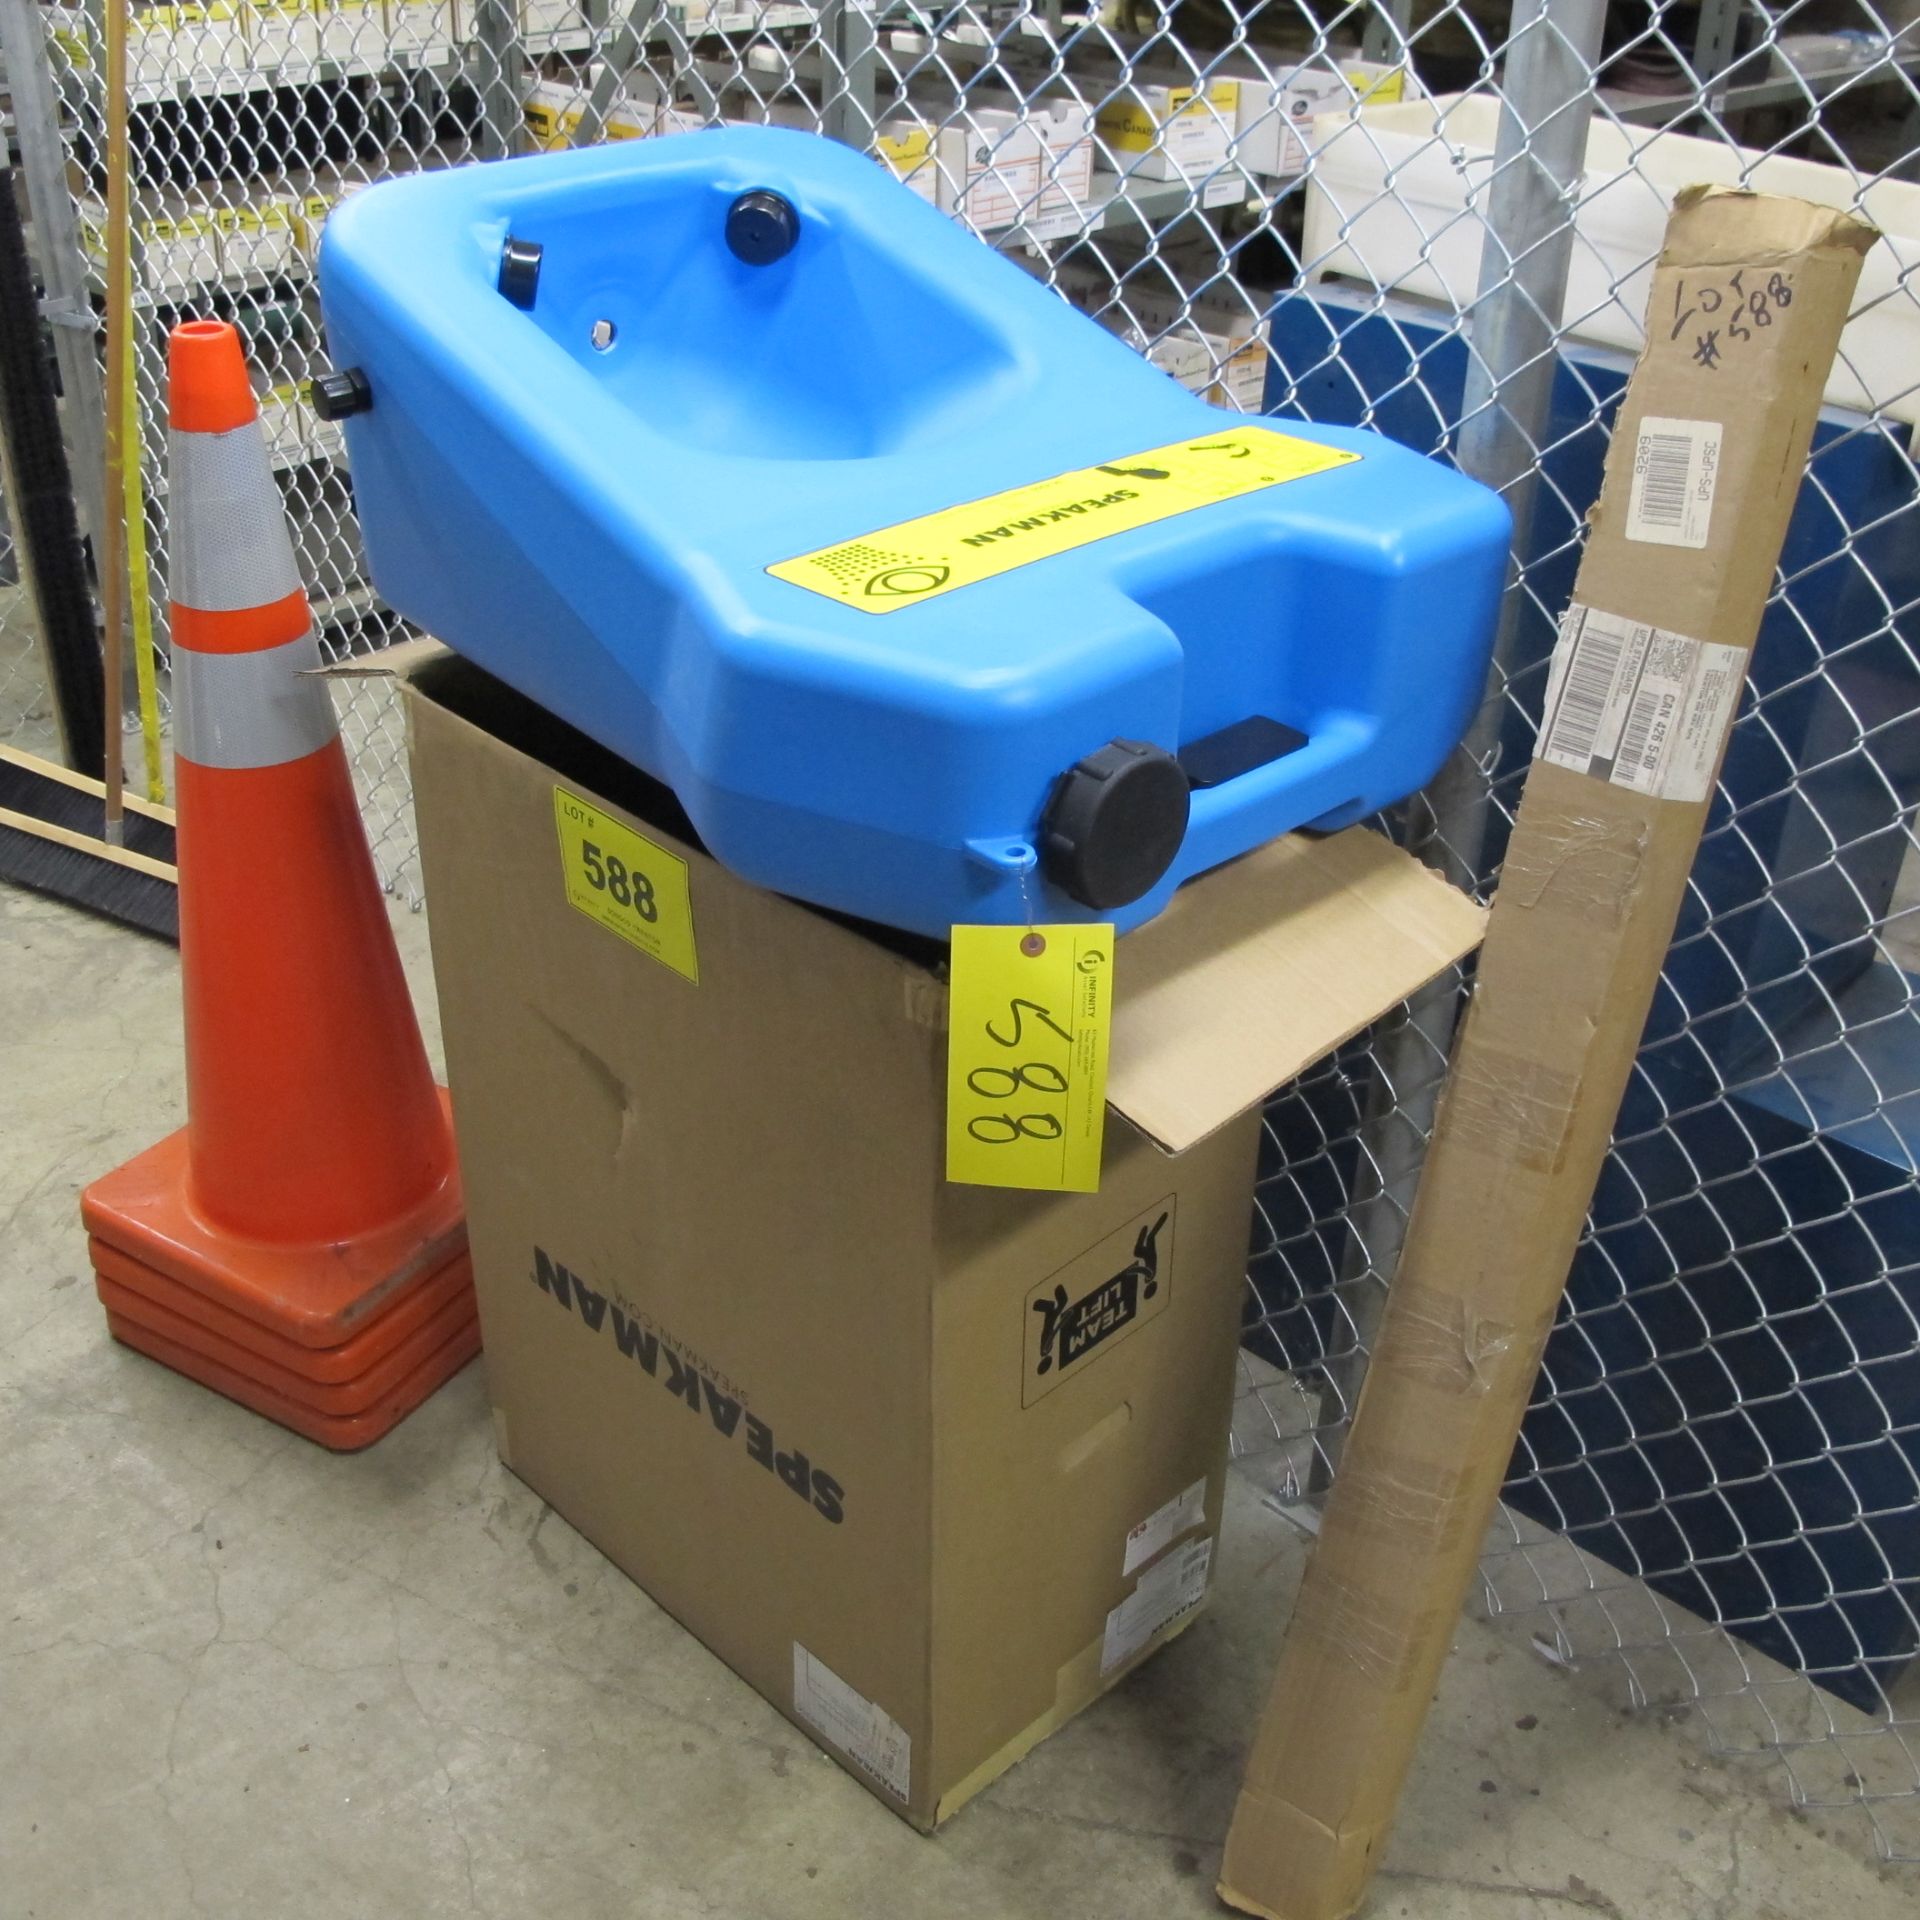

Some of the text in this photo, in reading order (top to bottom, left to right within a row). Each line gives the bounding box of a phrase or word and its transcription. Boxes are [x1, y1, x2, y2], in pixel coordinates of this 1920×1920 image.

[1635, 435, 1652, 475] 9209
[1696, 440, 1717, 502] UPS-UPSC
[961, 488, 1140, 548] SPEAKMAN
[1636, 628, 1649, 647] UPS
[1622, 648, 1641, 696] STANDARD
[1658, 693, 1676, 719] CAN
[1650, 721, 1667, 742] 426
[563, 801, 585, 825] LOT
[581, 838, 659, 924] 588
[1086, 976, 1098, 1018] INFINITY
[966, 997, 1075, 1144] 588
[1069, 1300, 1128, 1354] TEAM
[1075, 1280, 1123, 1327] LIFT
[533, 1245, 846, 1526] SPEAKMAN
